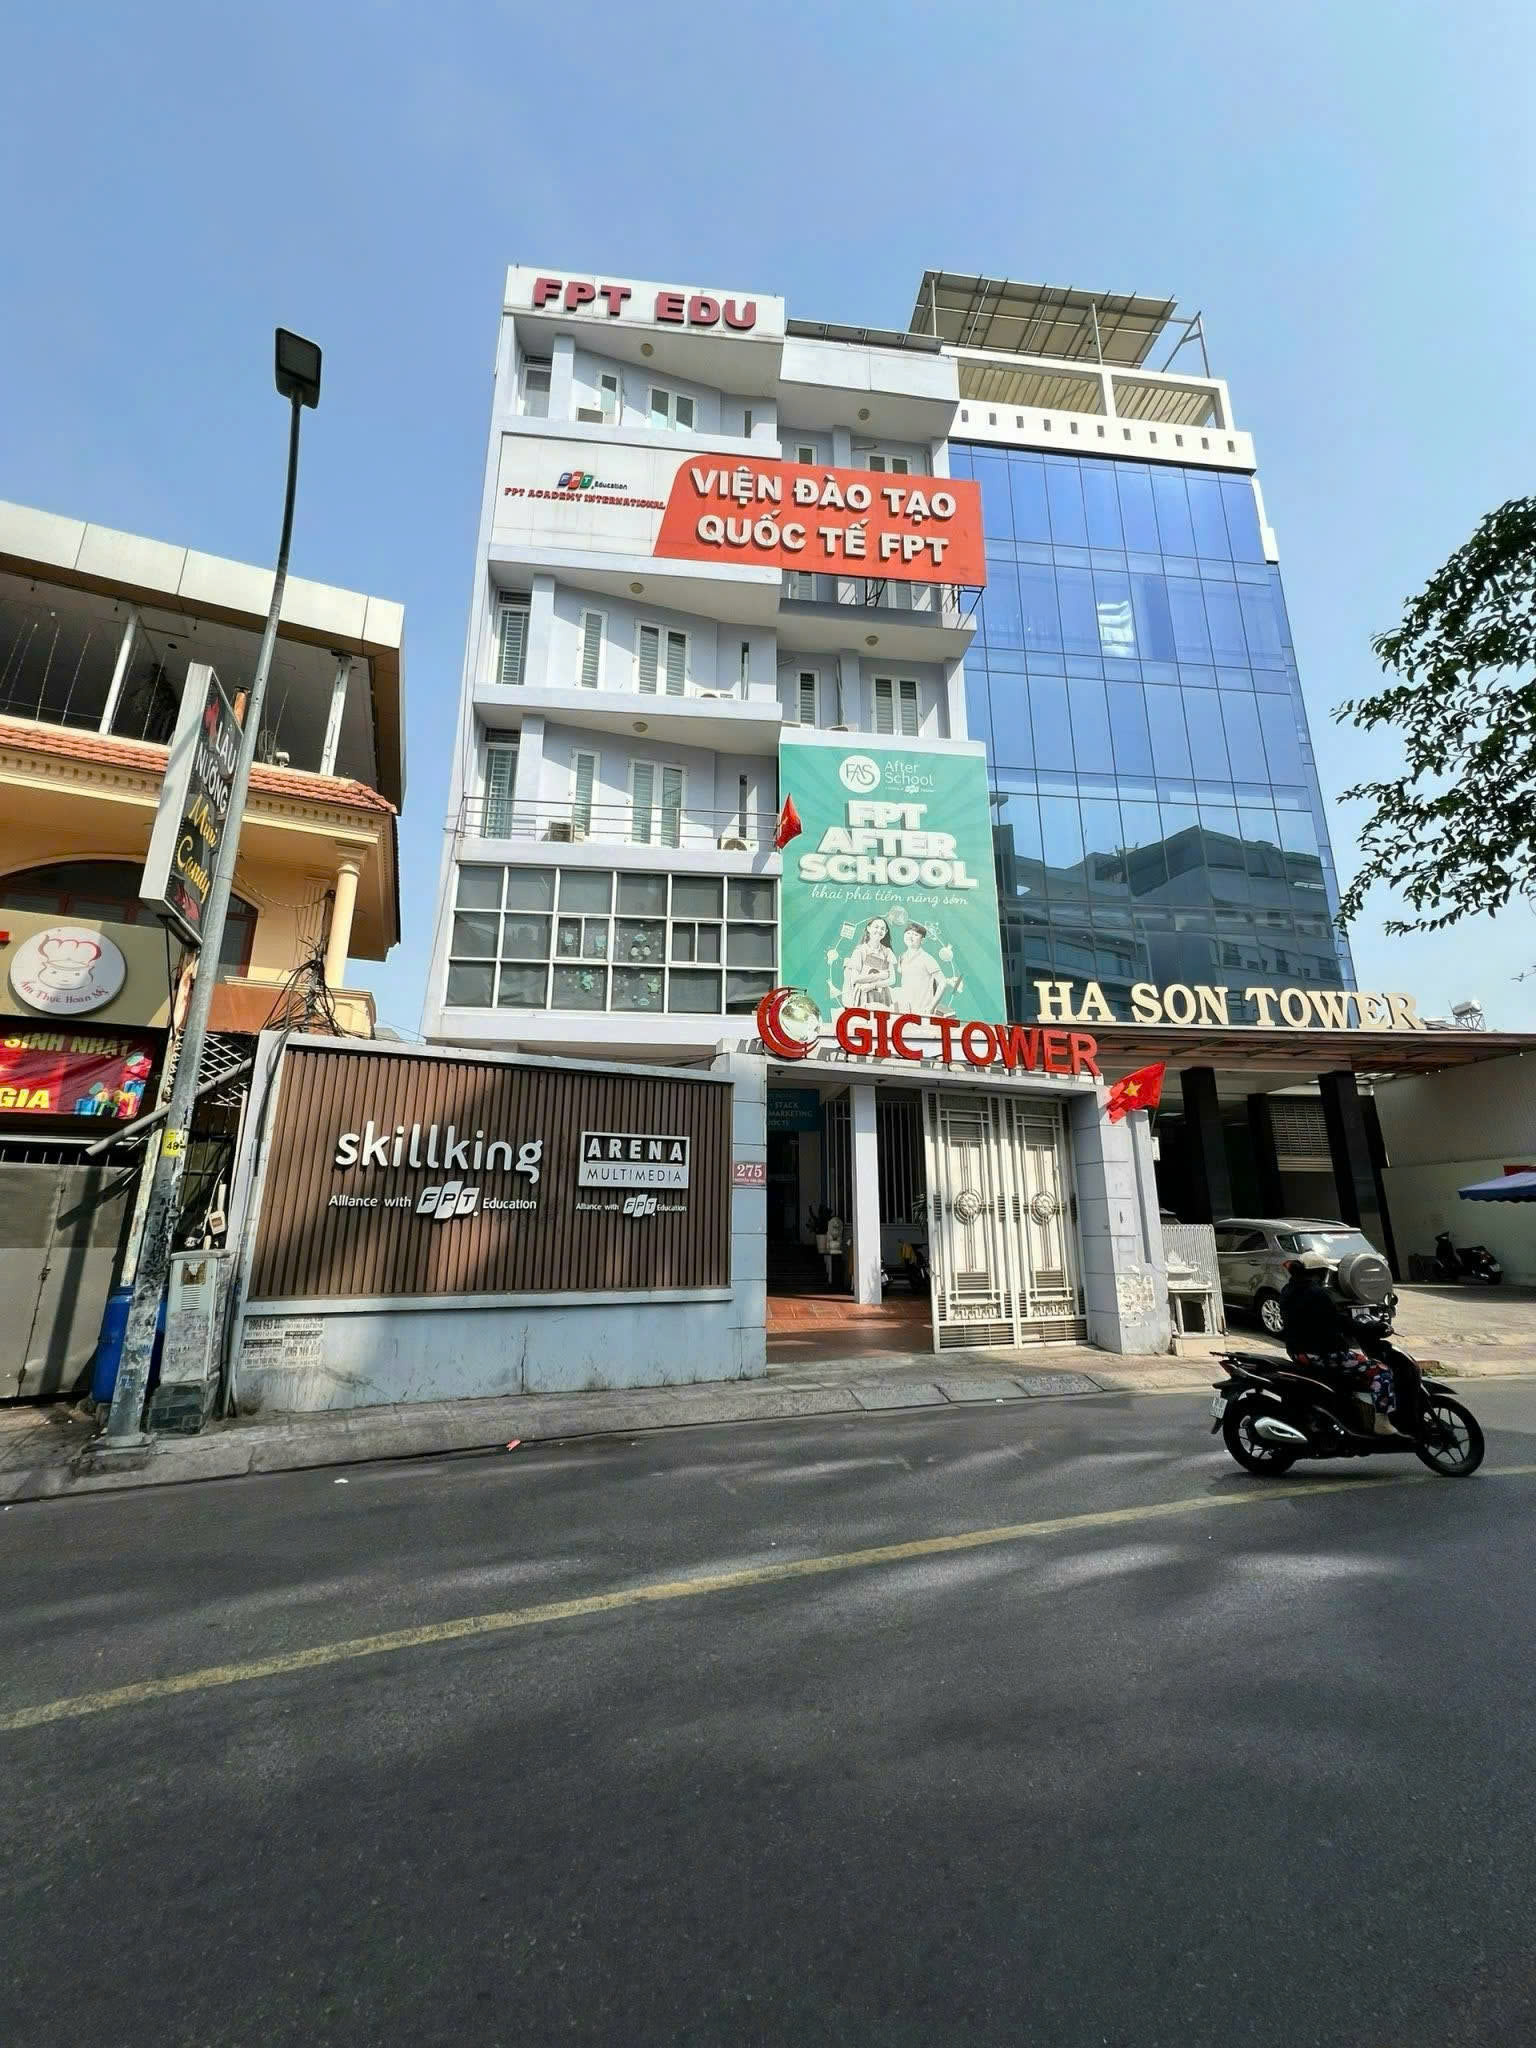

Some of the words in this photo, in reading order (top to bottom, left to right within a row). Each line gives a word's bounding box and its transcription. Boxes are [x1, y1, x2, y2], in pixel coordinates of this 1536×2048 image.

[533, 278, 631, 316] FPT
[655, 291, 756, 330] EDU
[557, 471, 593, 490] FPT
[594, 480, 627, 490] Education
[504, 487, 525, 497] FPT
[527, 490, 583, 503] ACADEMY
[584, 494, 666, 510] INTERNATIONAL
[691, 466, 782, 507] VIỆN
[794, 474, 872, 511] ĐÀO
[882, 487, 957, 523] TẠO
[697, 510, 806, 549] QUỐC
[819, 519, 868, 557] TẾ
[880, 532, 949, 563] FPT
[845, 763, 875, 786] FAS
[884, 760, 919, 773] After
[884, 771, 935, 786] School
[847, 800, 928, 831] FPT
[816, 826, 957, 860] AFTER
[799, 853, 979, 889] SCHOOL
[810, 884, 842, 899] khai
[1033, 981, 1116, 1022] HA
[1131, 983, 1229, 1026] SON
[1246, 986, 1427, 1031] TOWER
[835, 1007, 924, 1060] GIC
[929, 1015, 1101, 1077] TOWER
[335, 1120, 543, 1184] skillking
[587, 1138, 683, 1161] ARENA
[587, 1168, 682, 1182] MULTIMEDIA
[736, 1164, 762, 1178] 275
[328, 1194, 378, 1208] Alliance
[384, 1195, 412, 1208] with
[416, 1181, 480, 1219] FPT
[482, 1197, 537, 1210] Education
[576, 1203, 602, 1211] Alliance
[605, 1202, 620, 1211] with
[623, 1194, 657, 1217] FPT
[656, 1204, 687, 1213] Education
